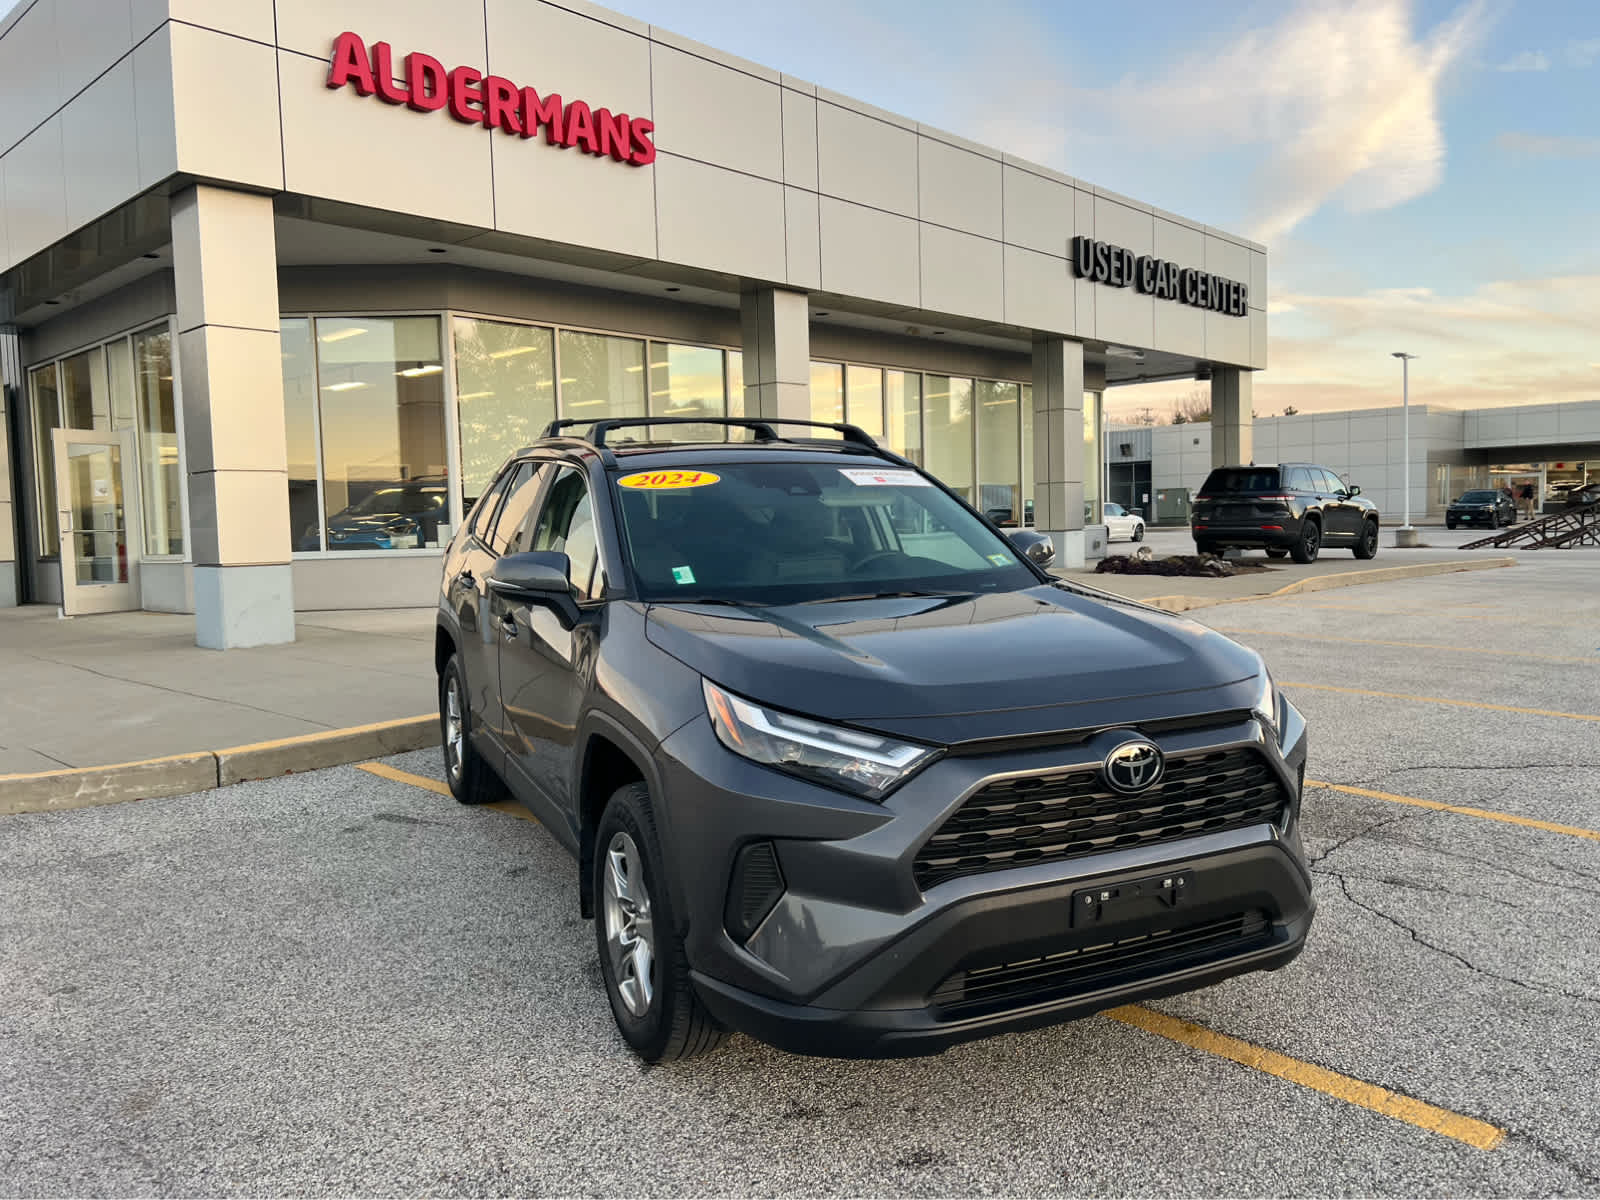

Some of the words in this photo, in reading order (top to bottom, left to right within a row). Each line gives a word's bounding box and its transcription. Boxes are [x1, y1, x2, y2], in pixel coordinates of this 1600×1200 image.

[326, 31, 656, 167] ALDERMANS
[1074, 236, 1137, 288] USED
[1138, 254, 1181, 300] CAR
[1182, 267, 1249, 317] CENTER
[632, 472, 703, 487] 2024
